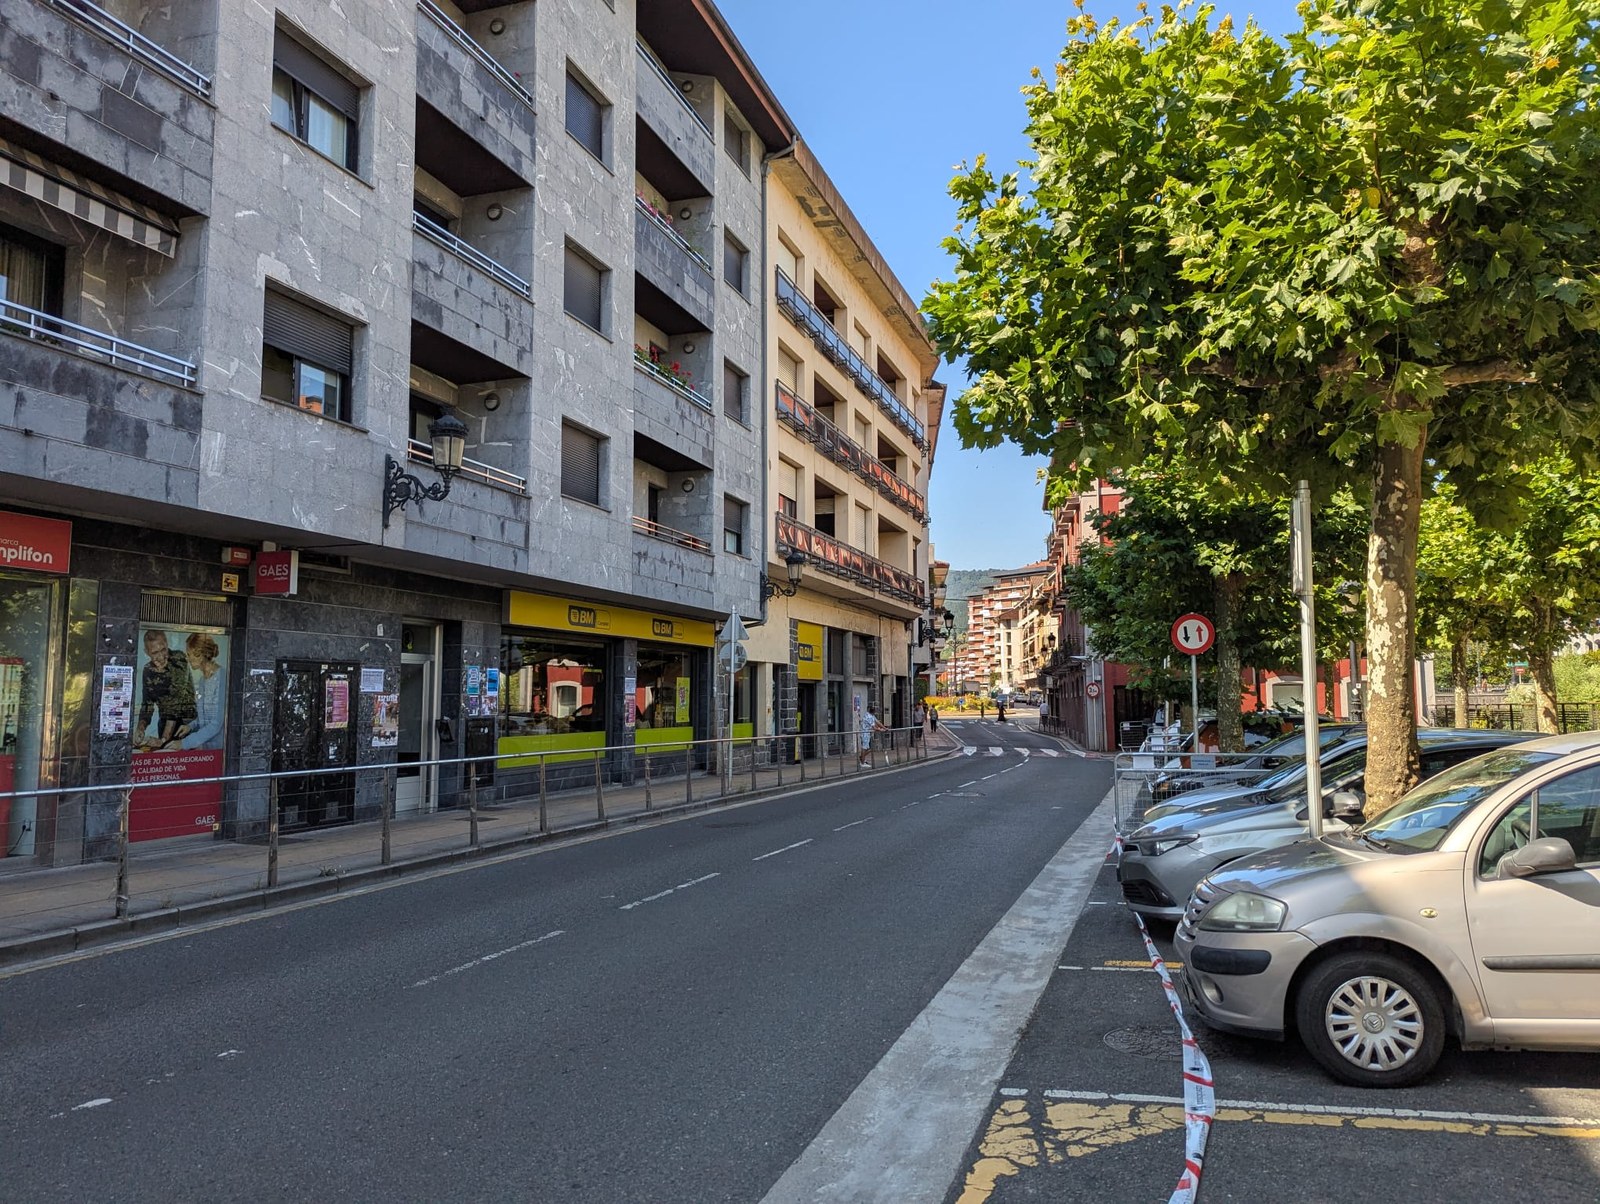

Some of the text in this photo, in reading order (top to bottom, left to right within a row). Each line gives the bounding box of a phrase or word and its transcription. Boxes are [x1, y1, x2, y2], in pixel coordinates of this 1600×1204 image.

[258, 563, 289, 577] GAES
[579, 610, 594, 625] BM
[661, 622, 672, 635] BM
[161, 756, 179, 764] AÑOS
[179, 755, 214, 763] MEJORANDO
[138, 766, 163, 774] CALIDAD
[195, 814, 216, 825] GAES
